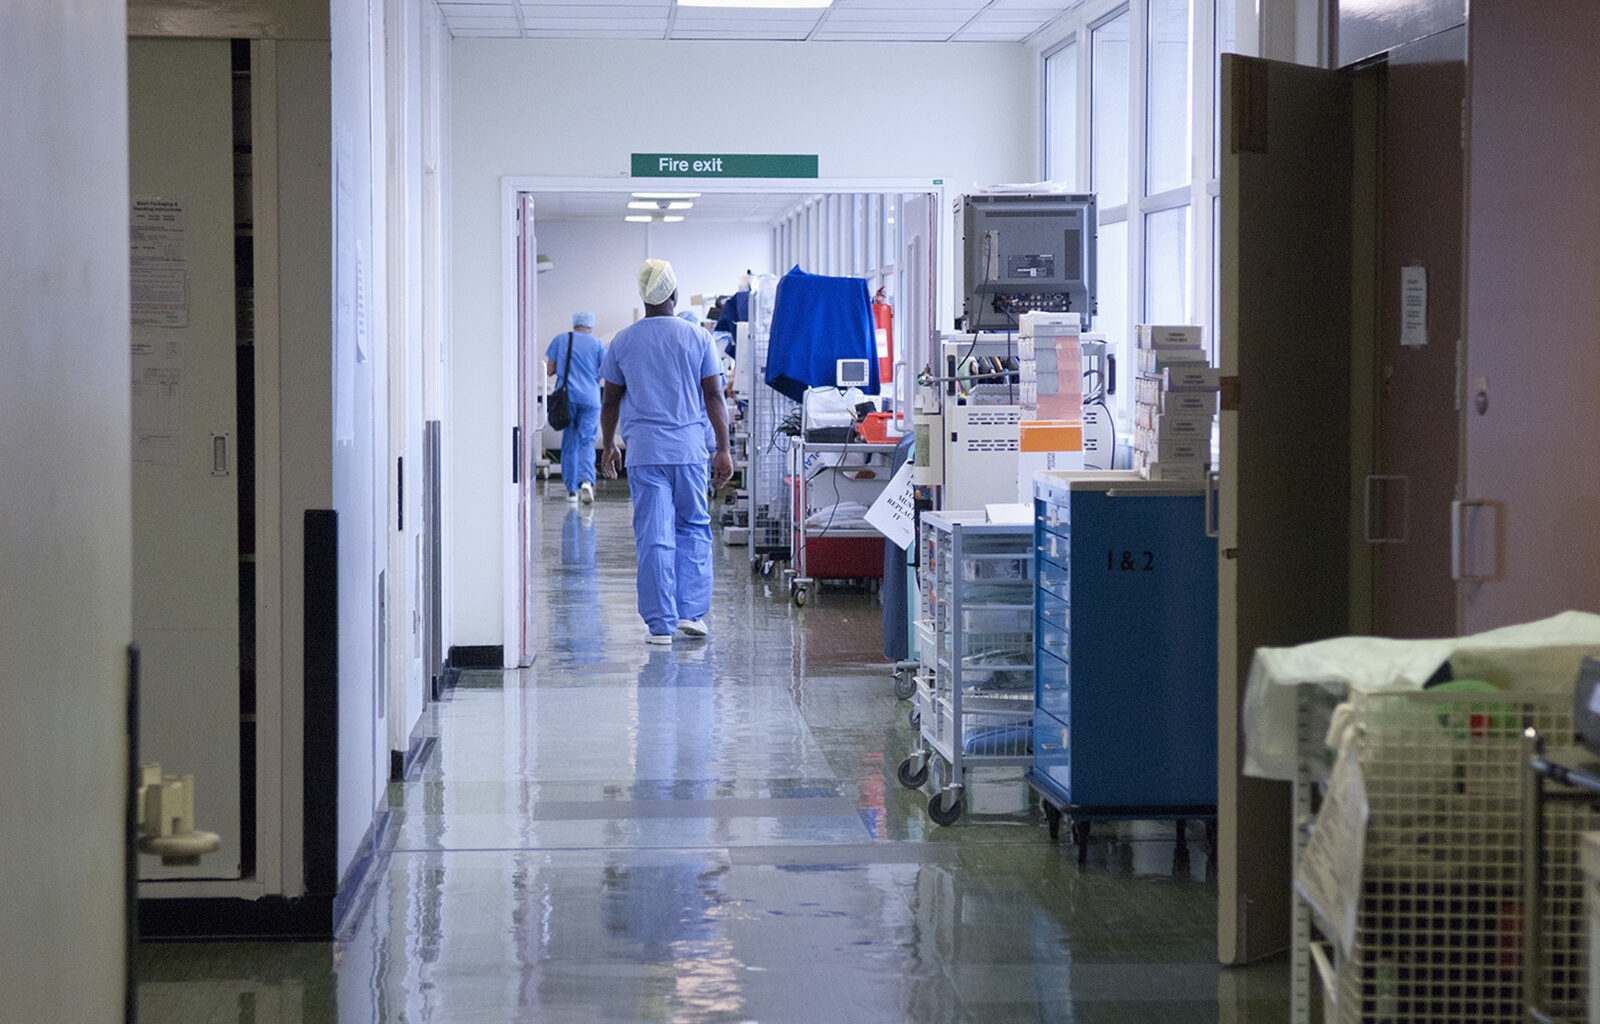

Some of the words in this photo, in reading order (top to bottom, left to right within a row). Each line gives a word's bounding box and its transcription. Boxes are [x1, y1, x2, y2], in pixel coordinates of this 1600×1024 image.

[659, 157, 689, 172] Fire
[693, 157, 723, 172] exit
[1121, 550, 1135, 571] &
[1143, 550, 1154, 571] 2
